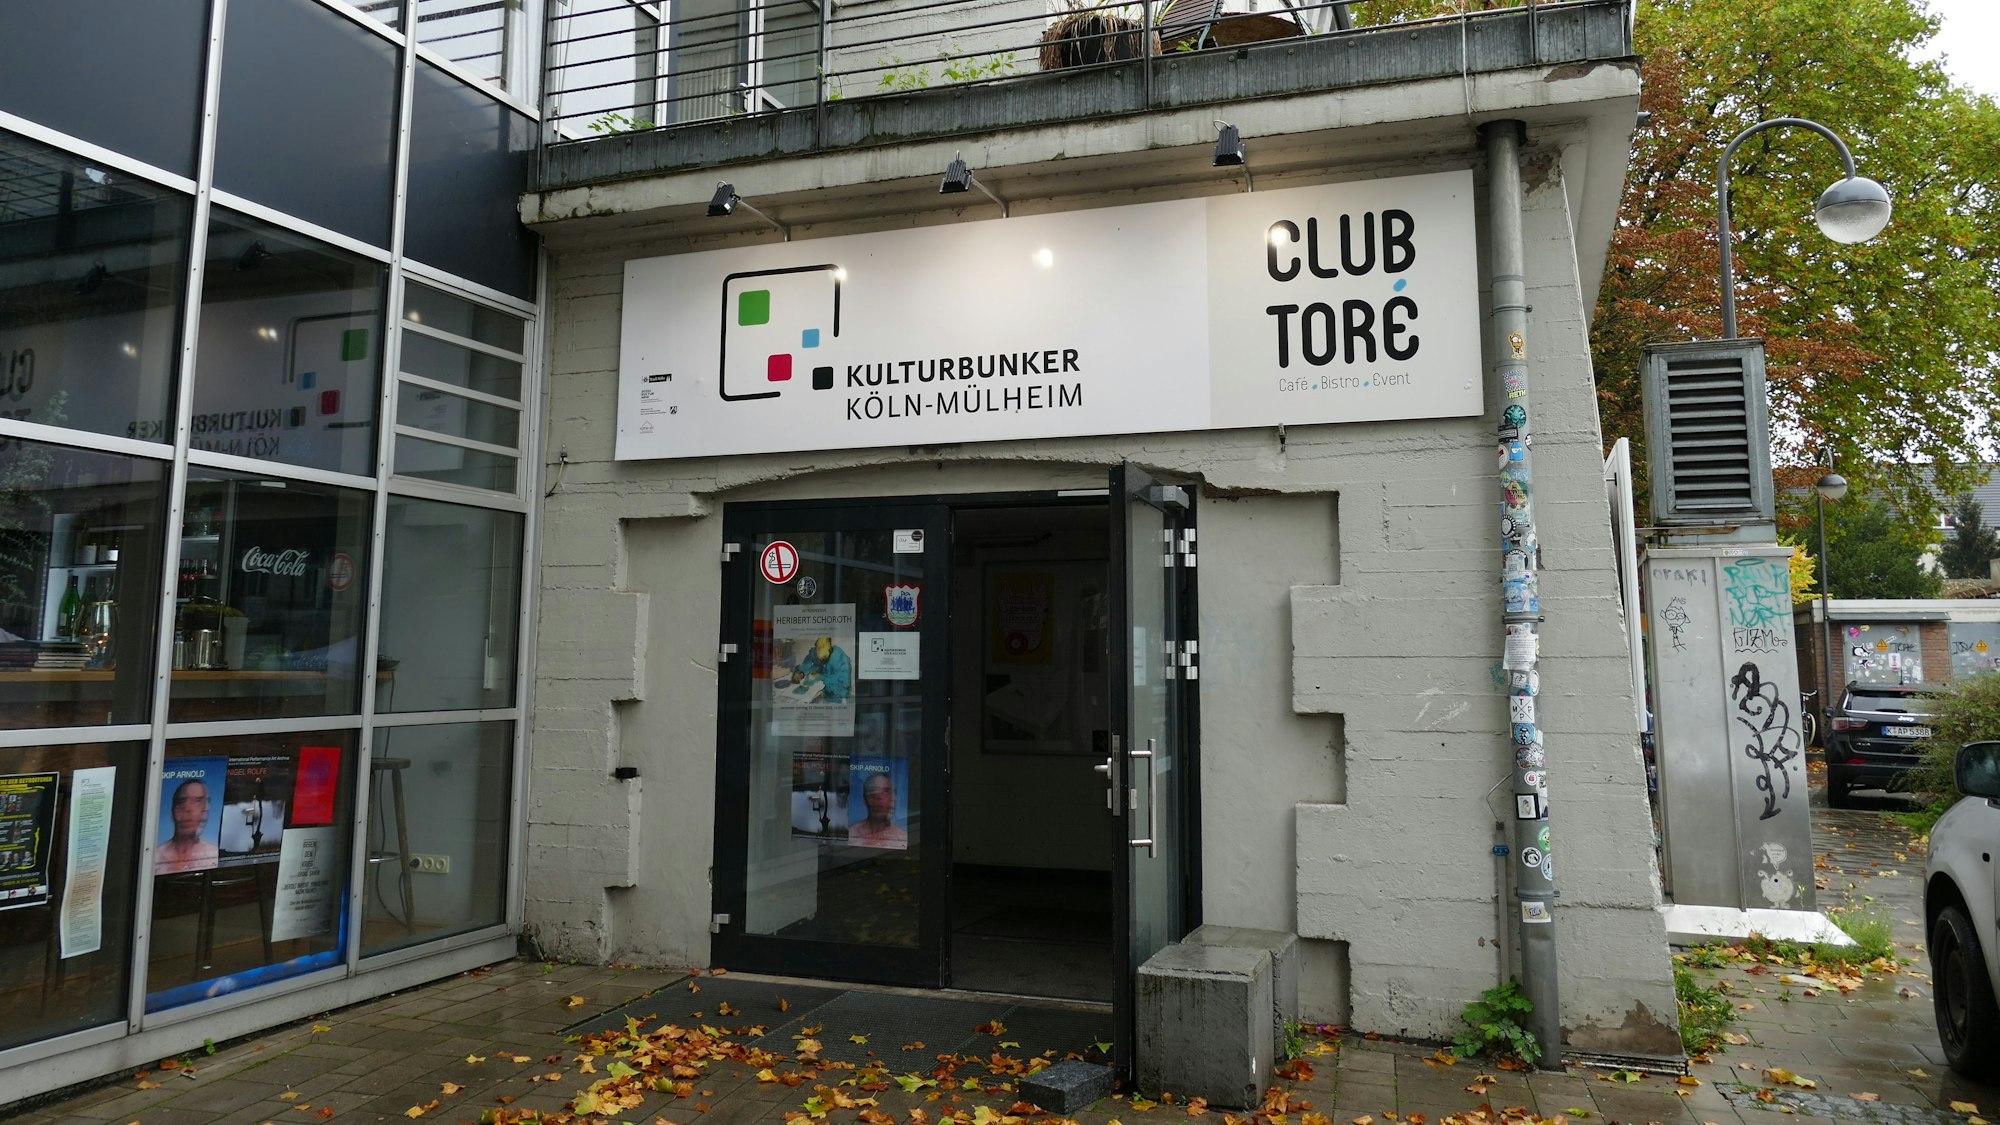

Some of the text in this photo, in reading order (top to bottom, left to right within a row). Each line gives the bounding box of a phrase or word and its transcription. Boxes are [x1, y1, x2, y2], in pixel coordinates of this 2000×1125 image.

[1266, 208, 1416, 282] CLUB
[1265, 278, 1420, 368] TORÉ
[847, 348, 1080, 388] KULTURBUNKER
[1279, 371, 1411, 392] Café Bistro Event
[847, 382, 1083, 421] KÖLN-MÜLHEIM
[241, 545, 310, 577] Coca-Cola
[776, 615, 852, 625] HERIBERT SCHOROTH
[176, 769, 205, 778] ARNOLD
[864, 764, 890, 772] ARNOLD
